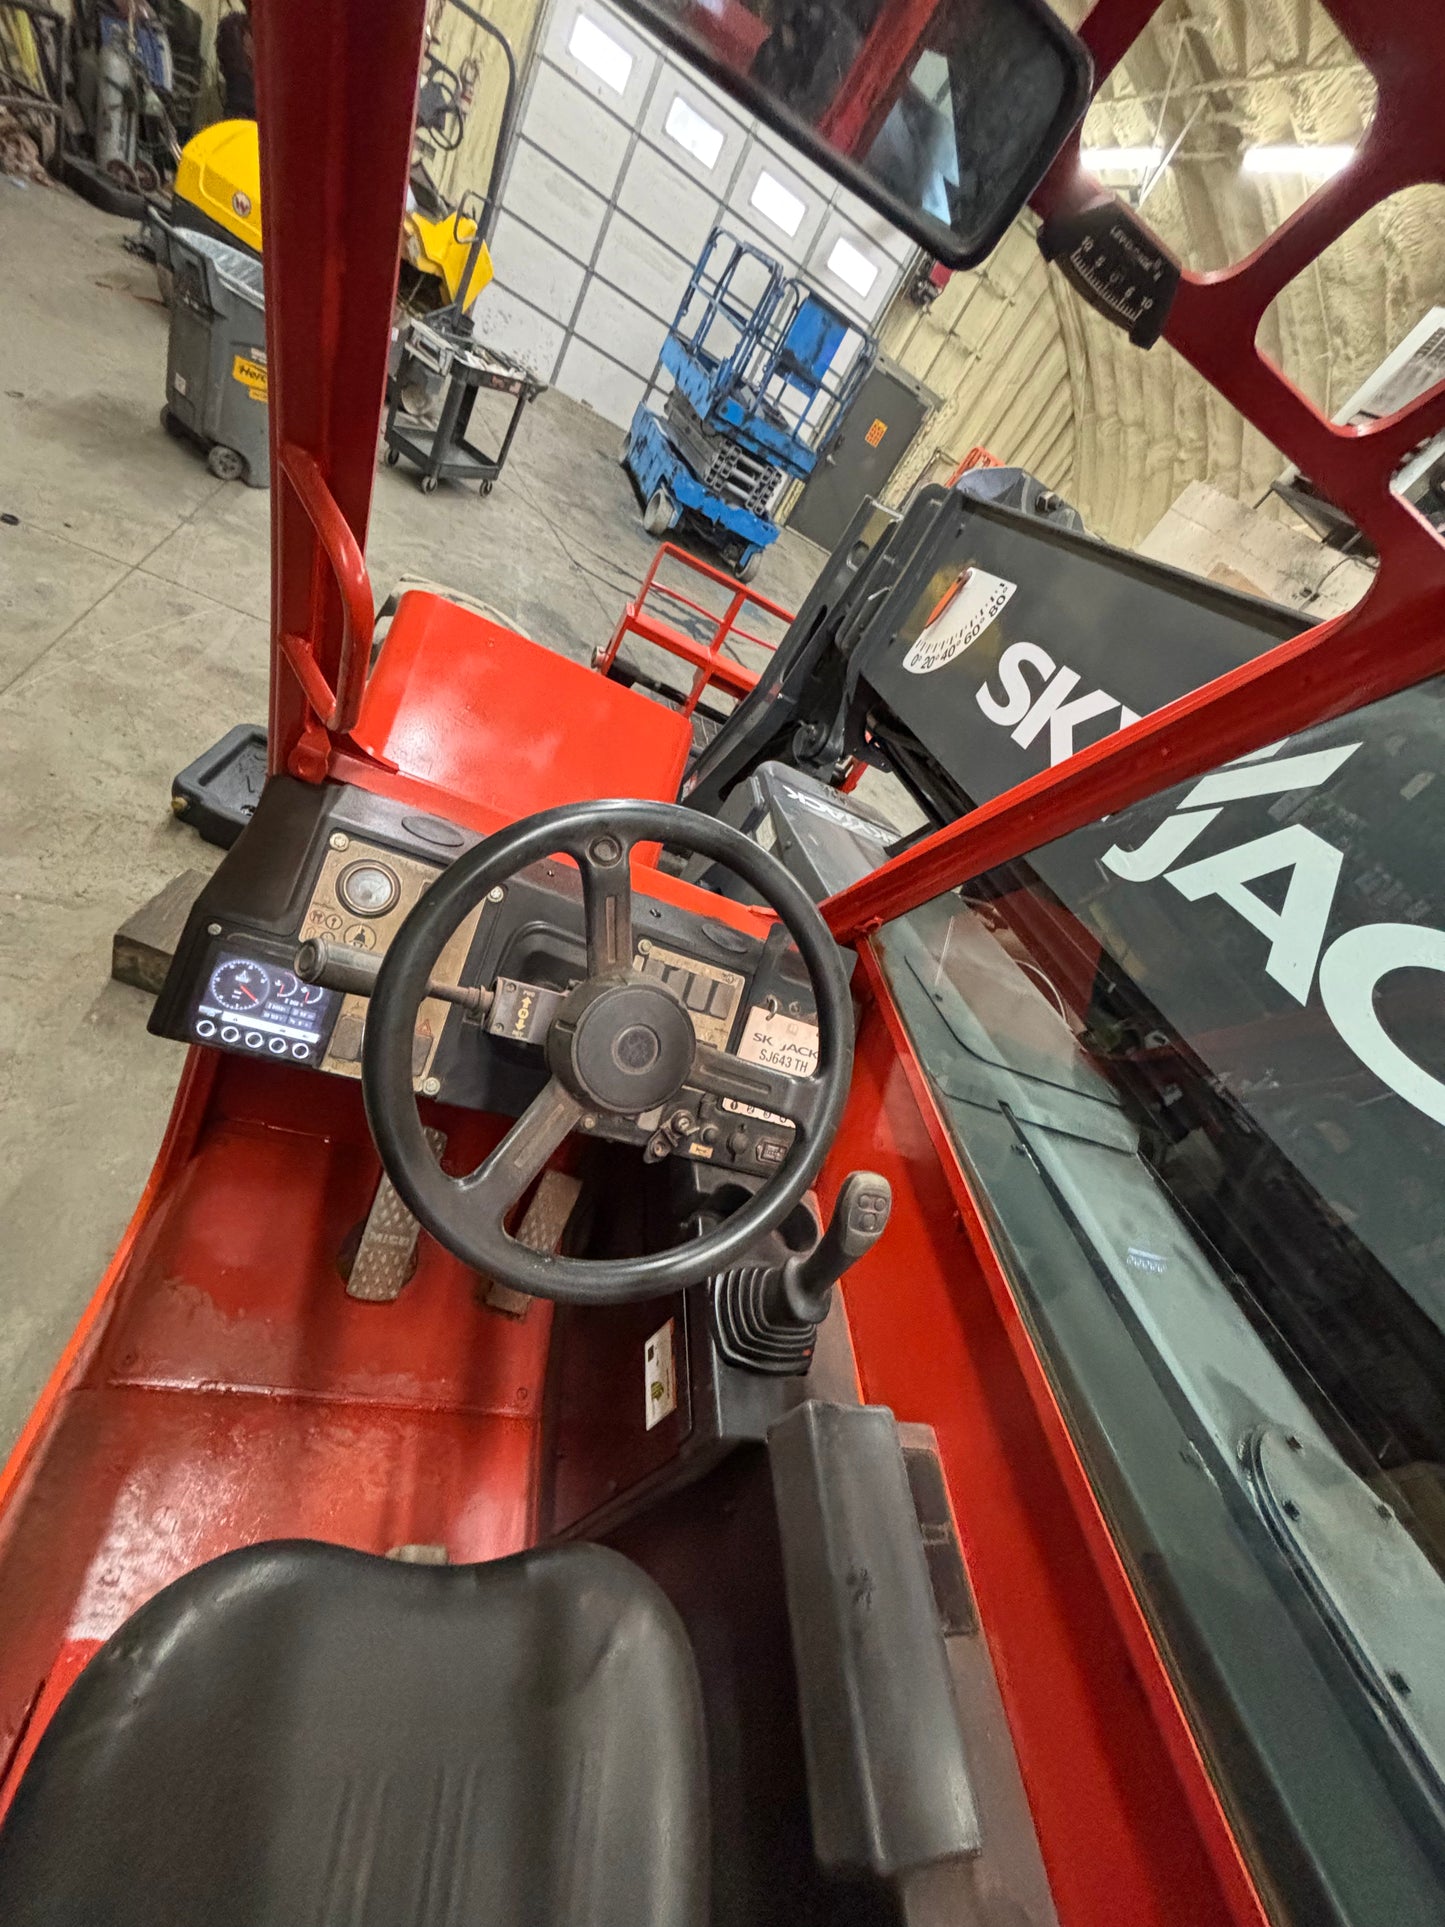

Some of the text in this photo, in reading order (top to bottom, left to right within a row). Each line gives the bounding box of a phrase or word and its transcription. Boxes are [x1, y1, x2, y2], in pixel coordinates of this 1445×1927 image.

[1141, 297, 1153, 310] 10
[759, 1049, 809, 1073] SJ643 TH
